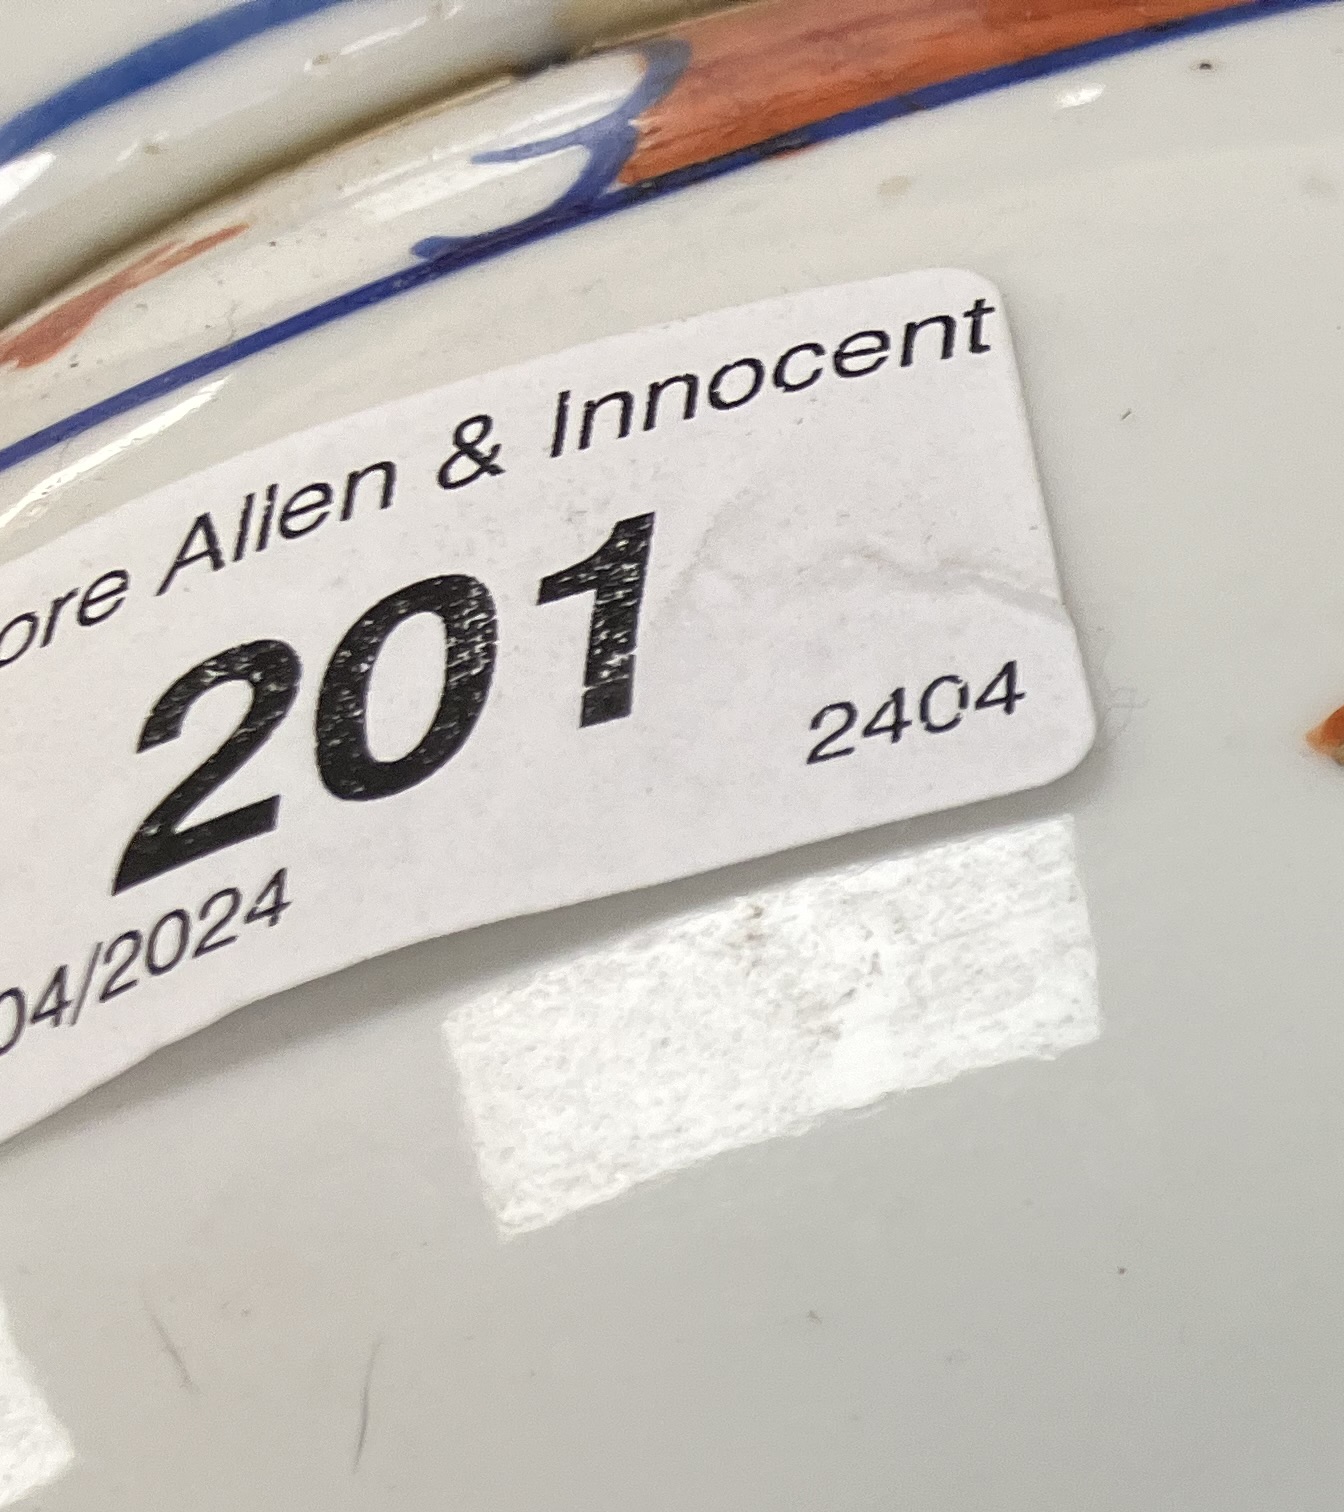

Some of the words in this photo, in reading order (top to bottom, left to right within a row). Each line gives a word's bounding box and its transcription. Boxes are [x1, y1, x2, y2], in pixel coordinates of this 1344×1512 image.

[155, 459, 396, 597] Allen
[436, 413, 506, 490] &
[549, 297, 997, 460] Innocent
[110, 511, 657, 896] 201
[805, 660, 1027, 766] 2404
